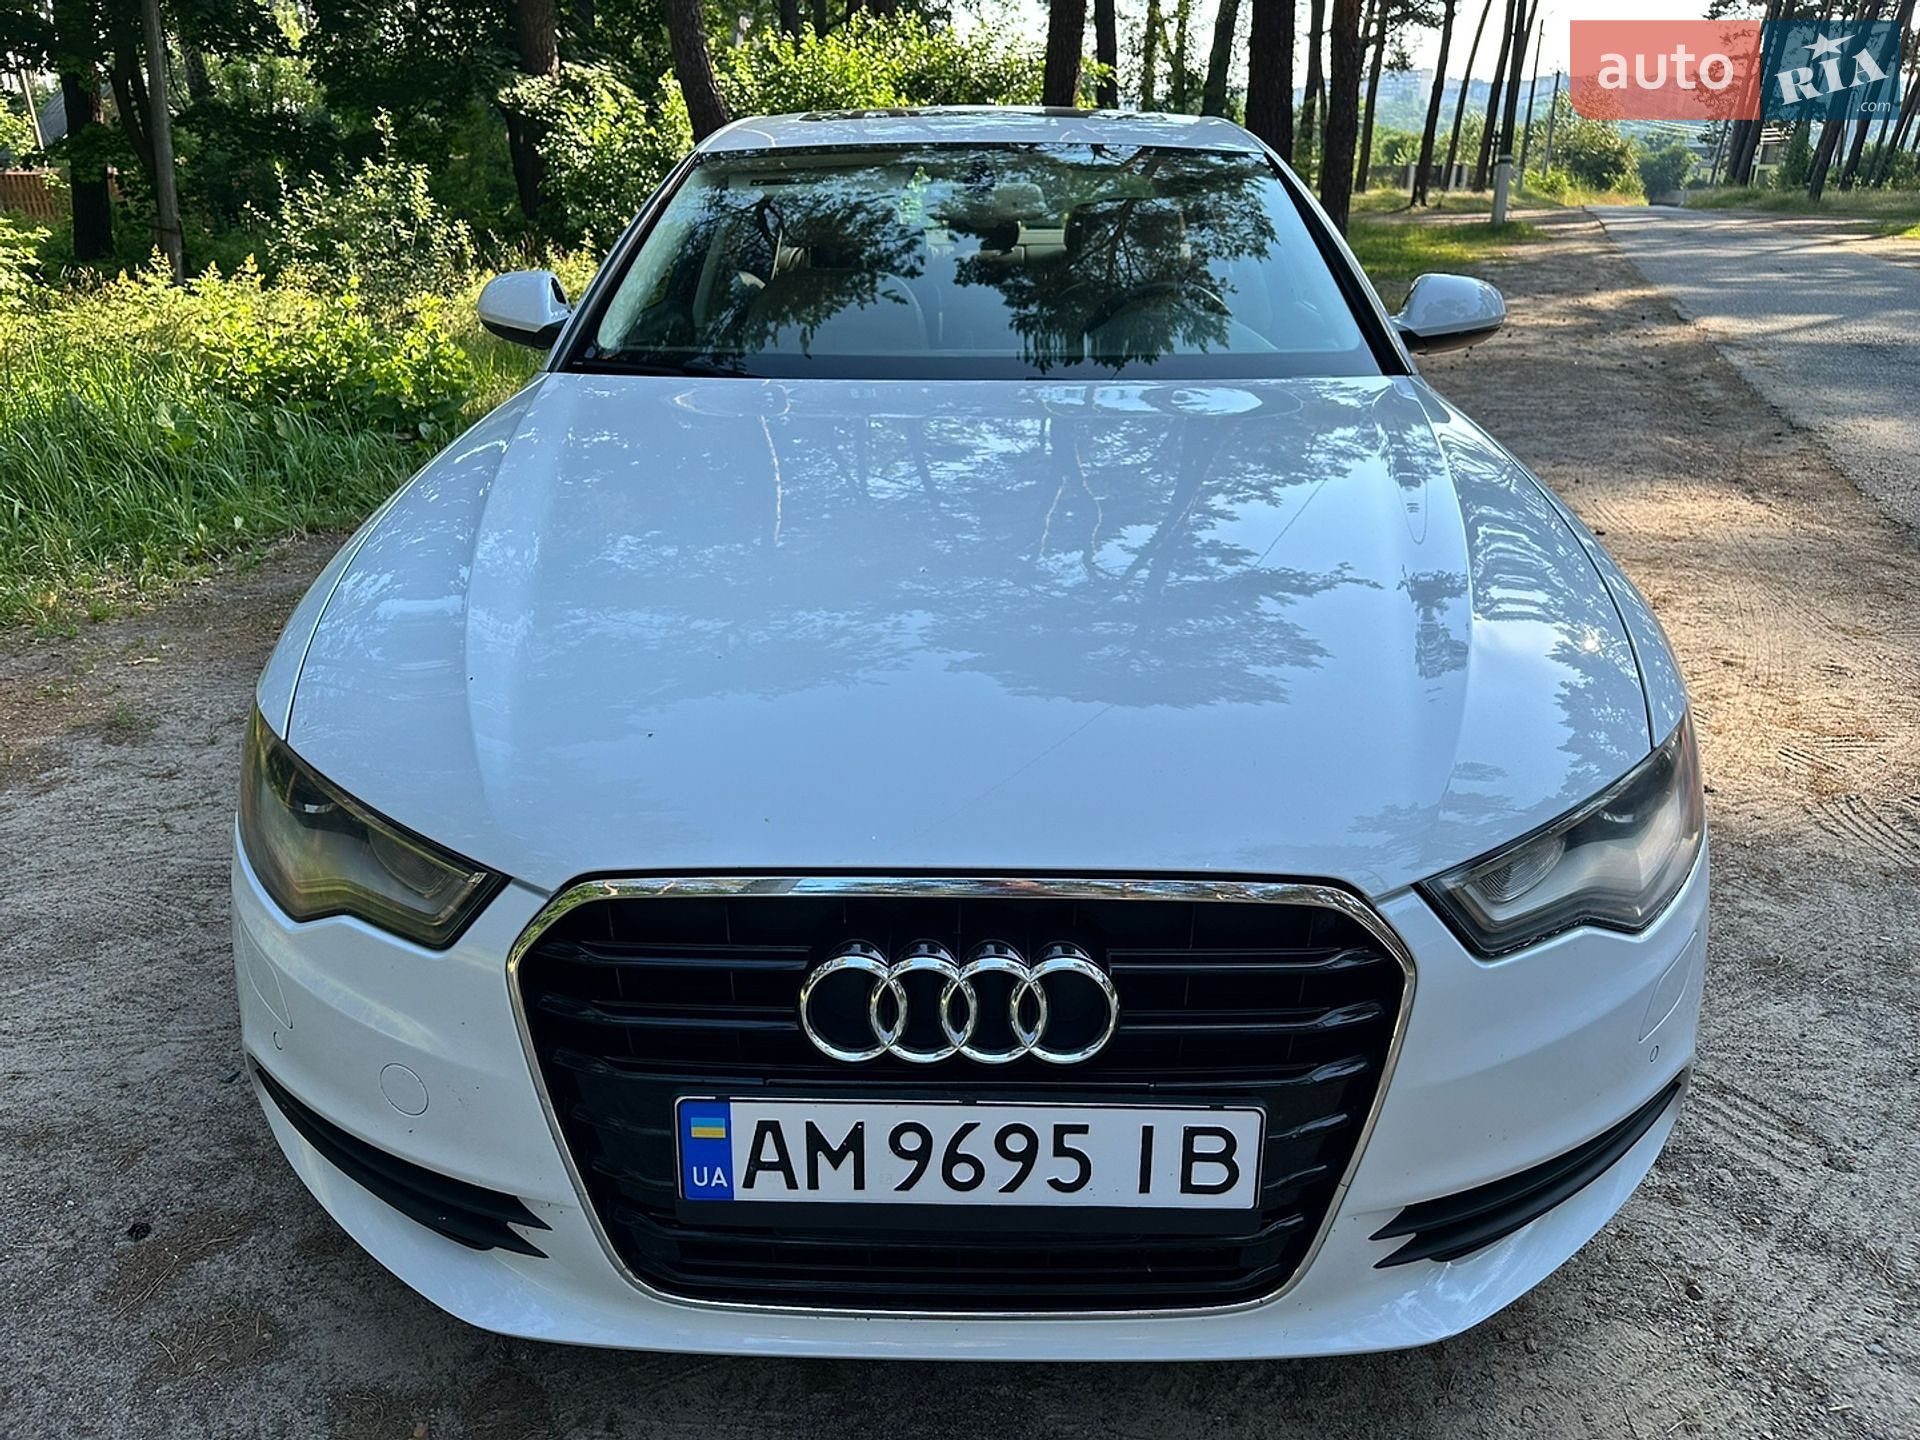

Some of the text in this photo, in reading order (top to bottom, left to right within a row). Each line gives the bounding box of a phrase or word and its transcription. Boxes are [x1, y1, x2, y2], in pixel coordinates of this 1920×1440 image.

[692, 1166, 728, 1187] UA
[741, 1119, 1240, 1196] AM 9695 IB
